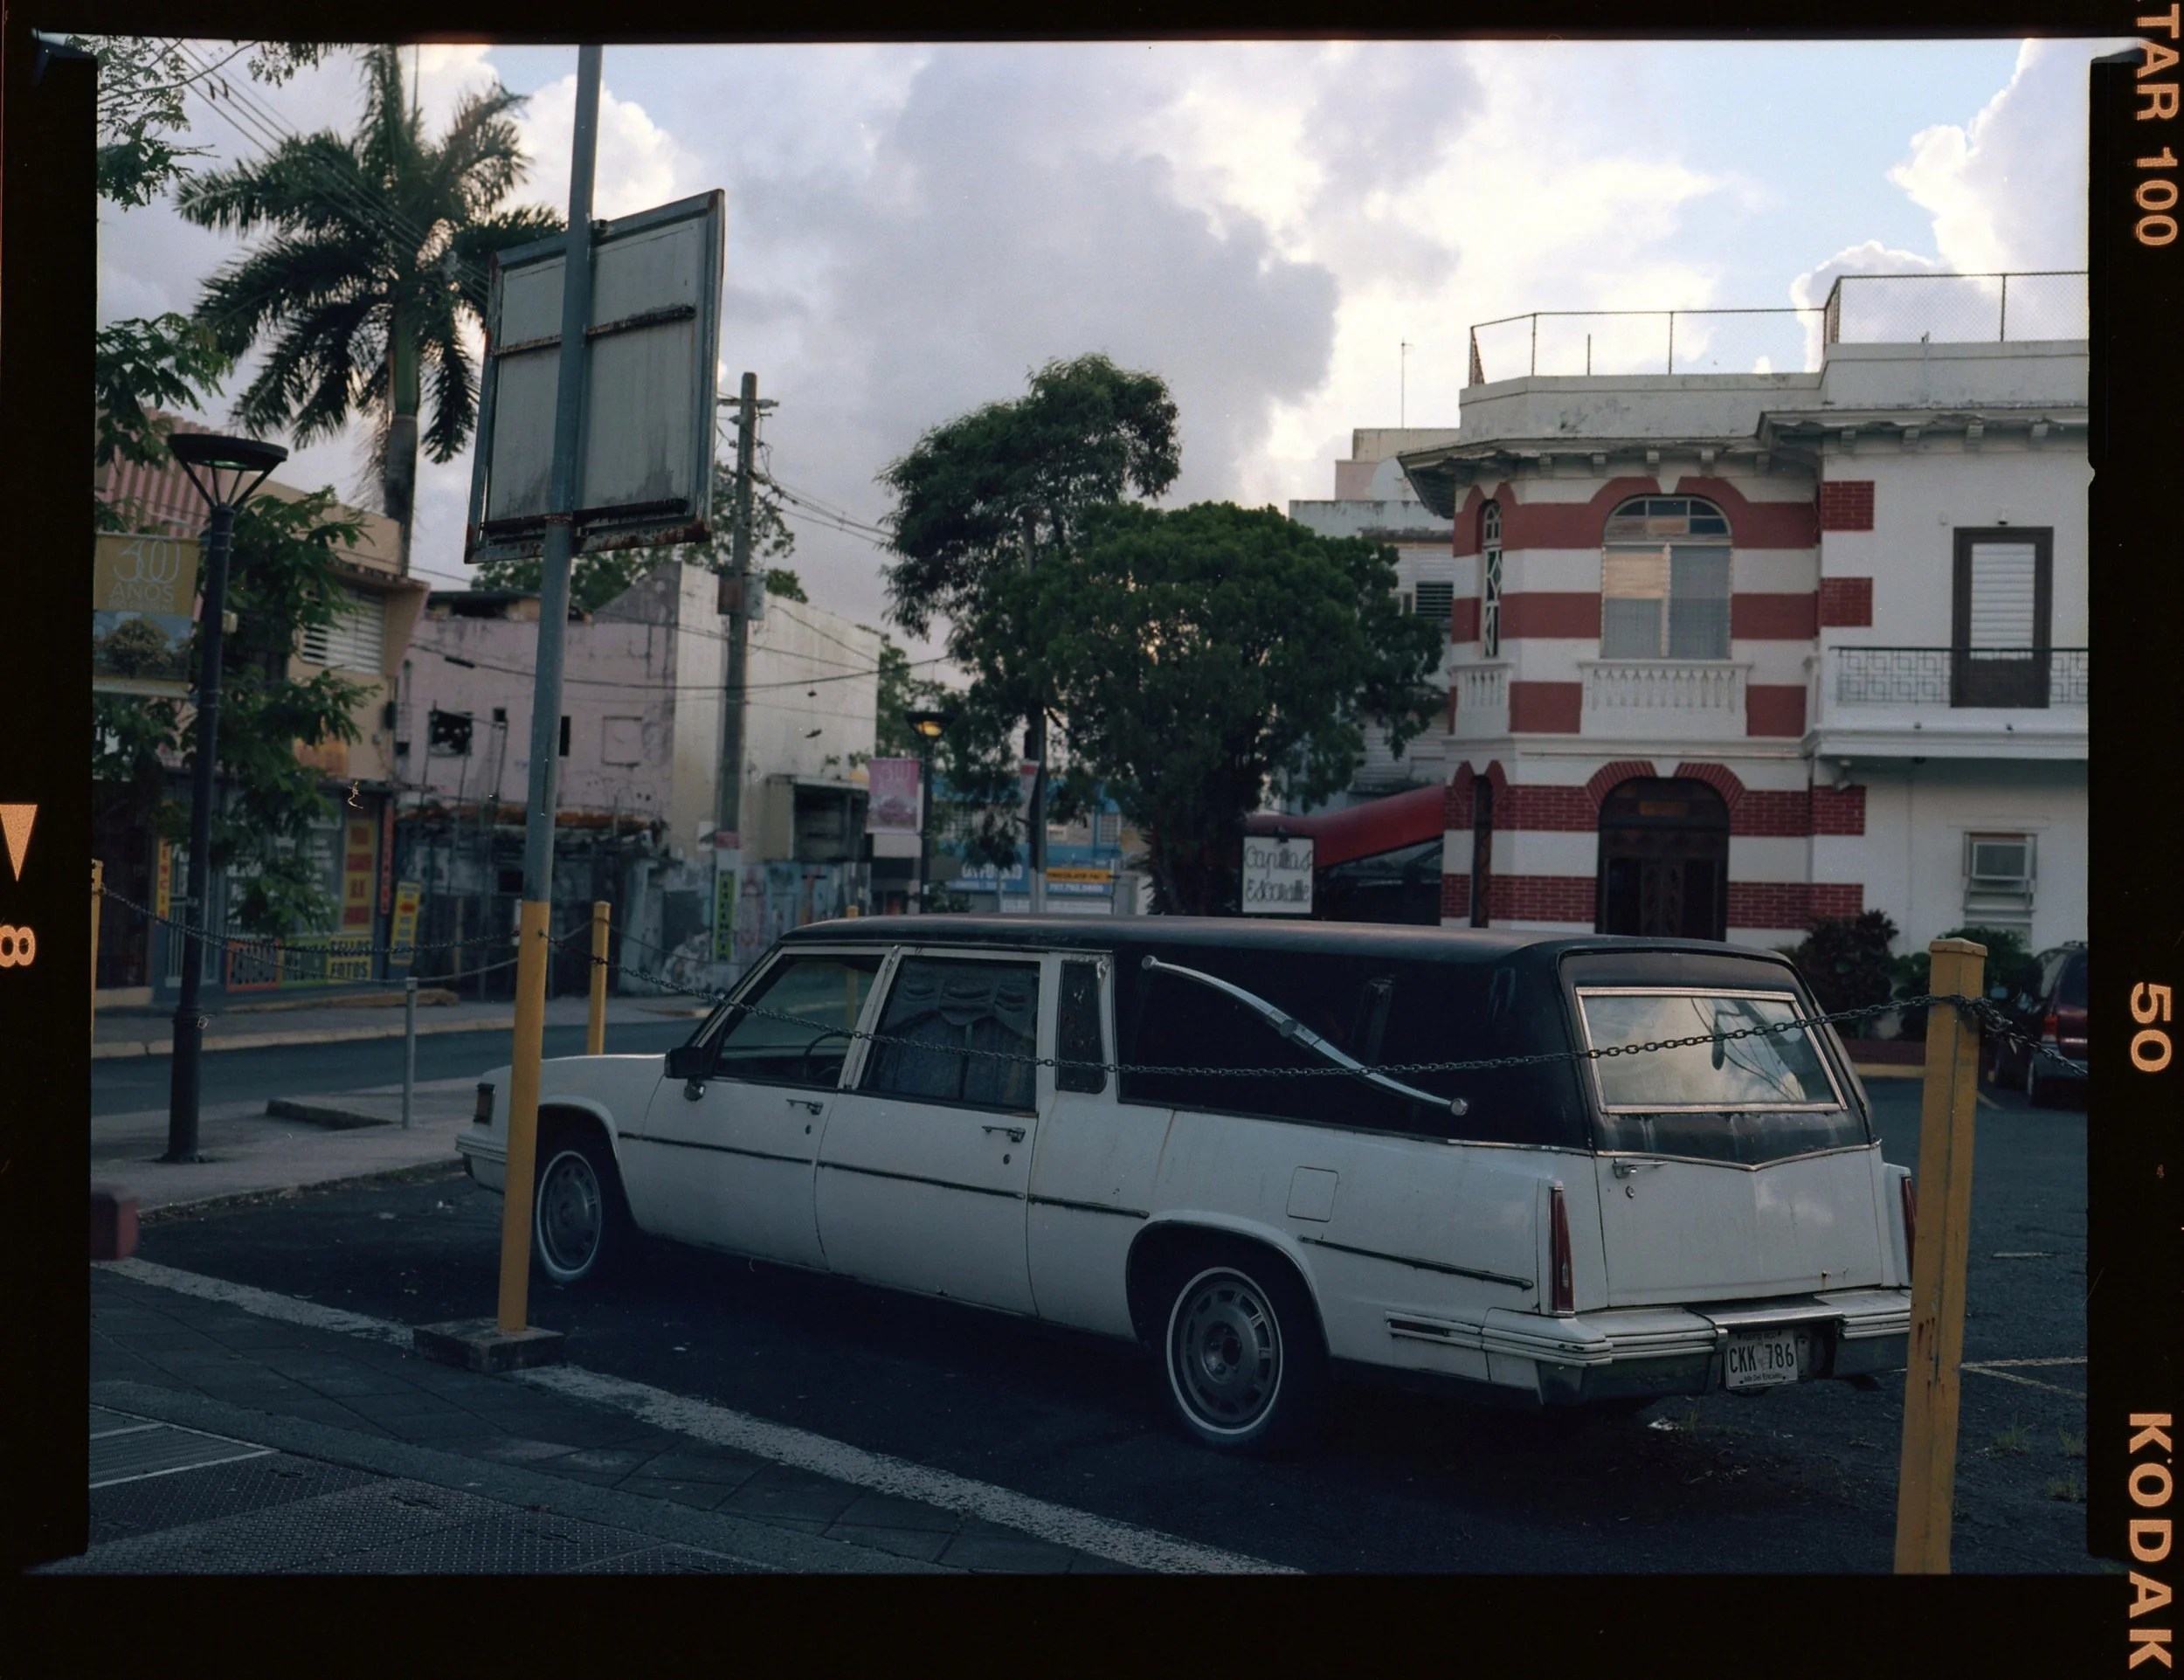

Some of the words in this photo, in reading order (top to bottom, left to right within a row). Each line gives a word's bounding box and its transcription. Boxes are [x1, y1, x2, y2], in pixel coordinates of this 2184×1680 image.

[2137, 3, 2180, 121] TAR
[2137, 146, 2179, 245] 100
[2130, 981, 2172, 1073] 50
[1729, 1345, 1757, 1373] CKK
[1765, 1344, 1794, 1370] 786
[2128, 1413, 2173, 1670] KODAK
